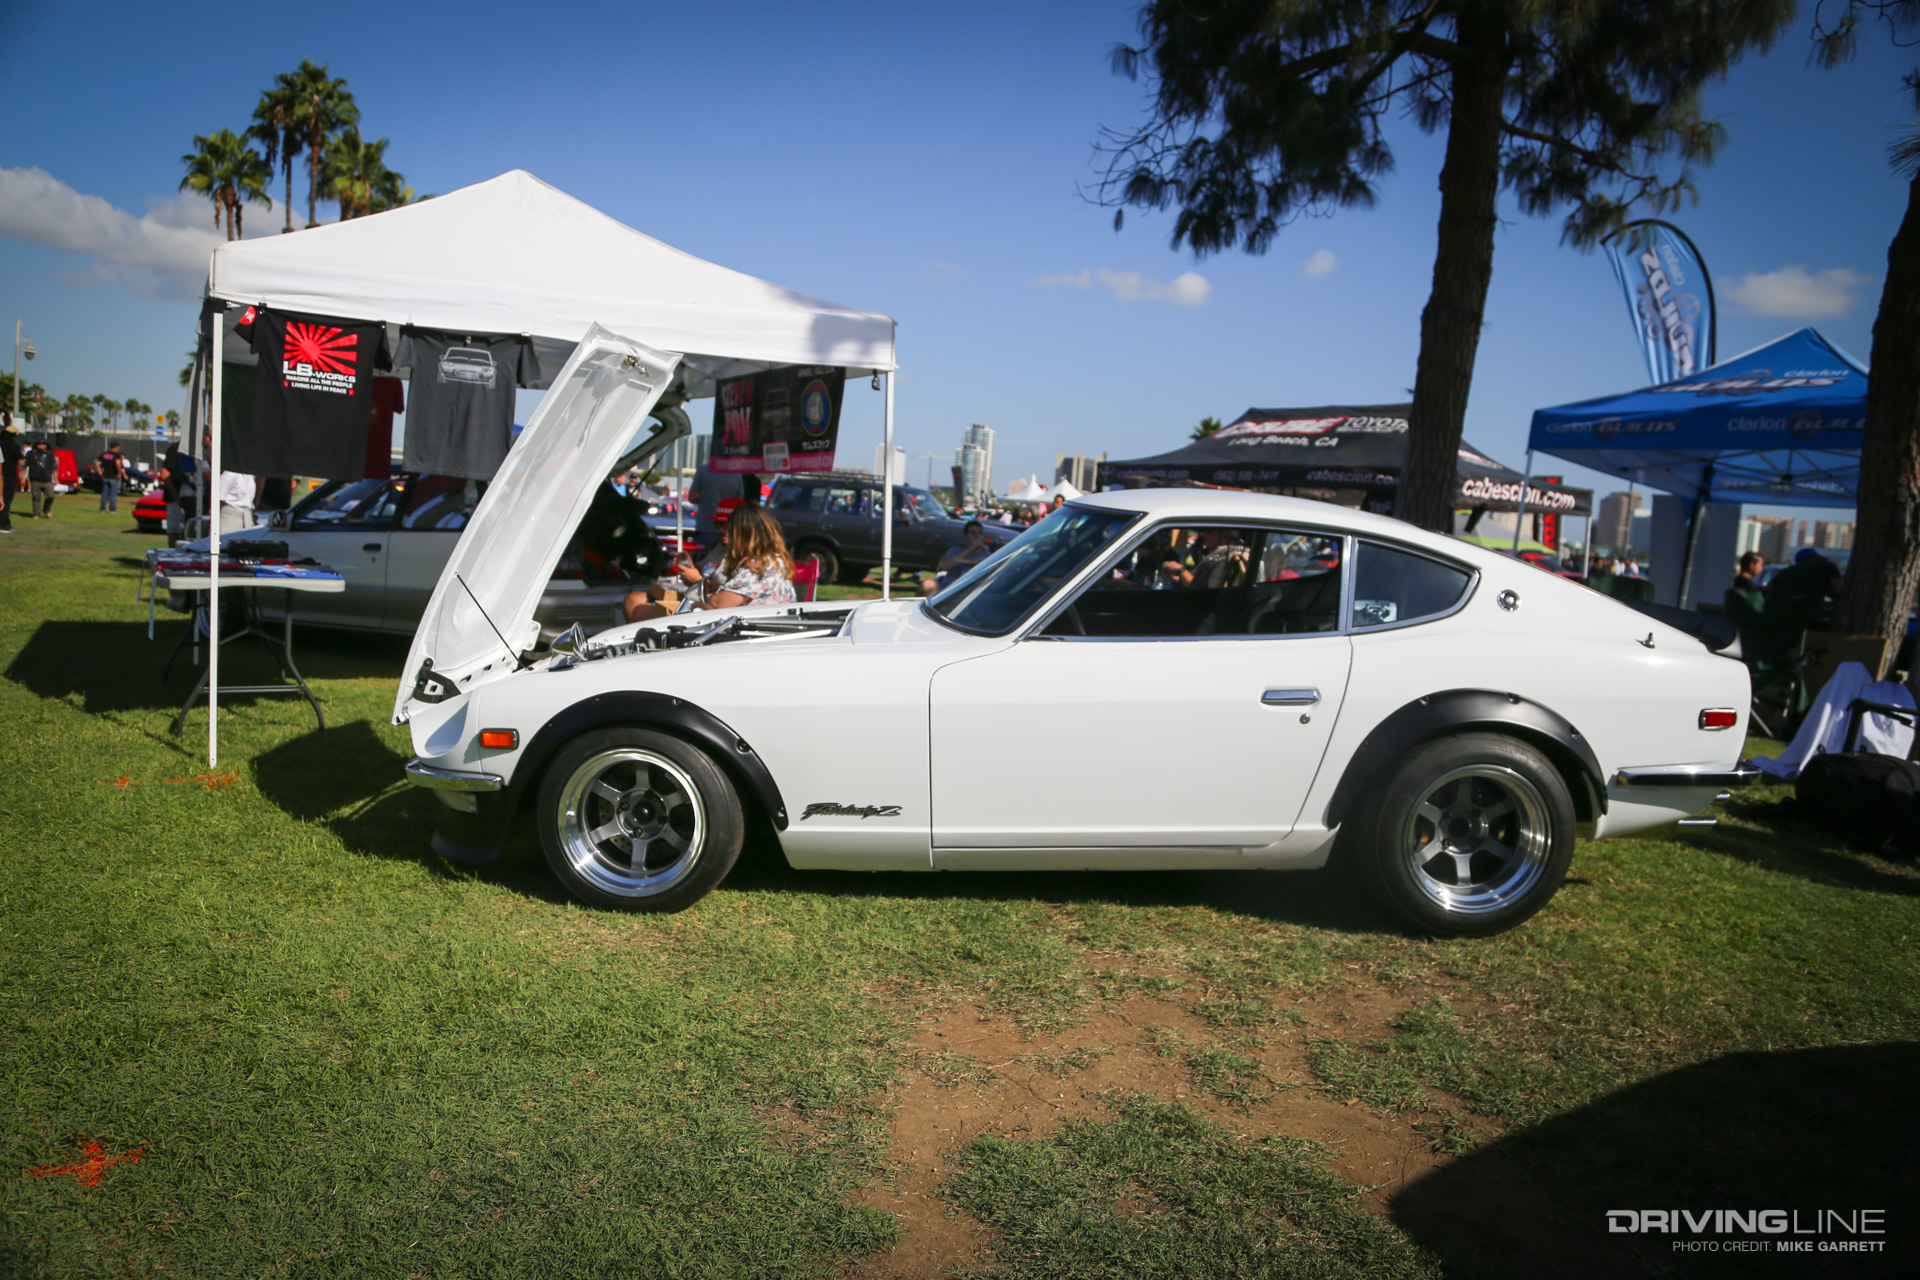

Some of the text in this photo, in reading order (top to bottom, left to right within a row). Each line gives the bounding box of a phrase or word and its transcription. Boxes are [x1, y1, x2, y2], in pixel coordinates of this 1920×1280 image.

[285, 374, 310, 383] IMAGINE
[332, 380, 353, 389] PEOPLE
[291, 381, 310, 390] LIVING
[329, 386, 347, 394] PEACE
[1727, 415, 1787, 431] clarion
[1314, 437, 1340, 447] CA
[1461, 476, 1576, 510] cabescion.com
